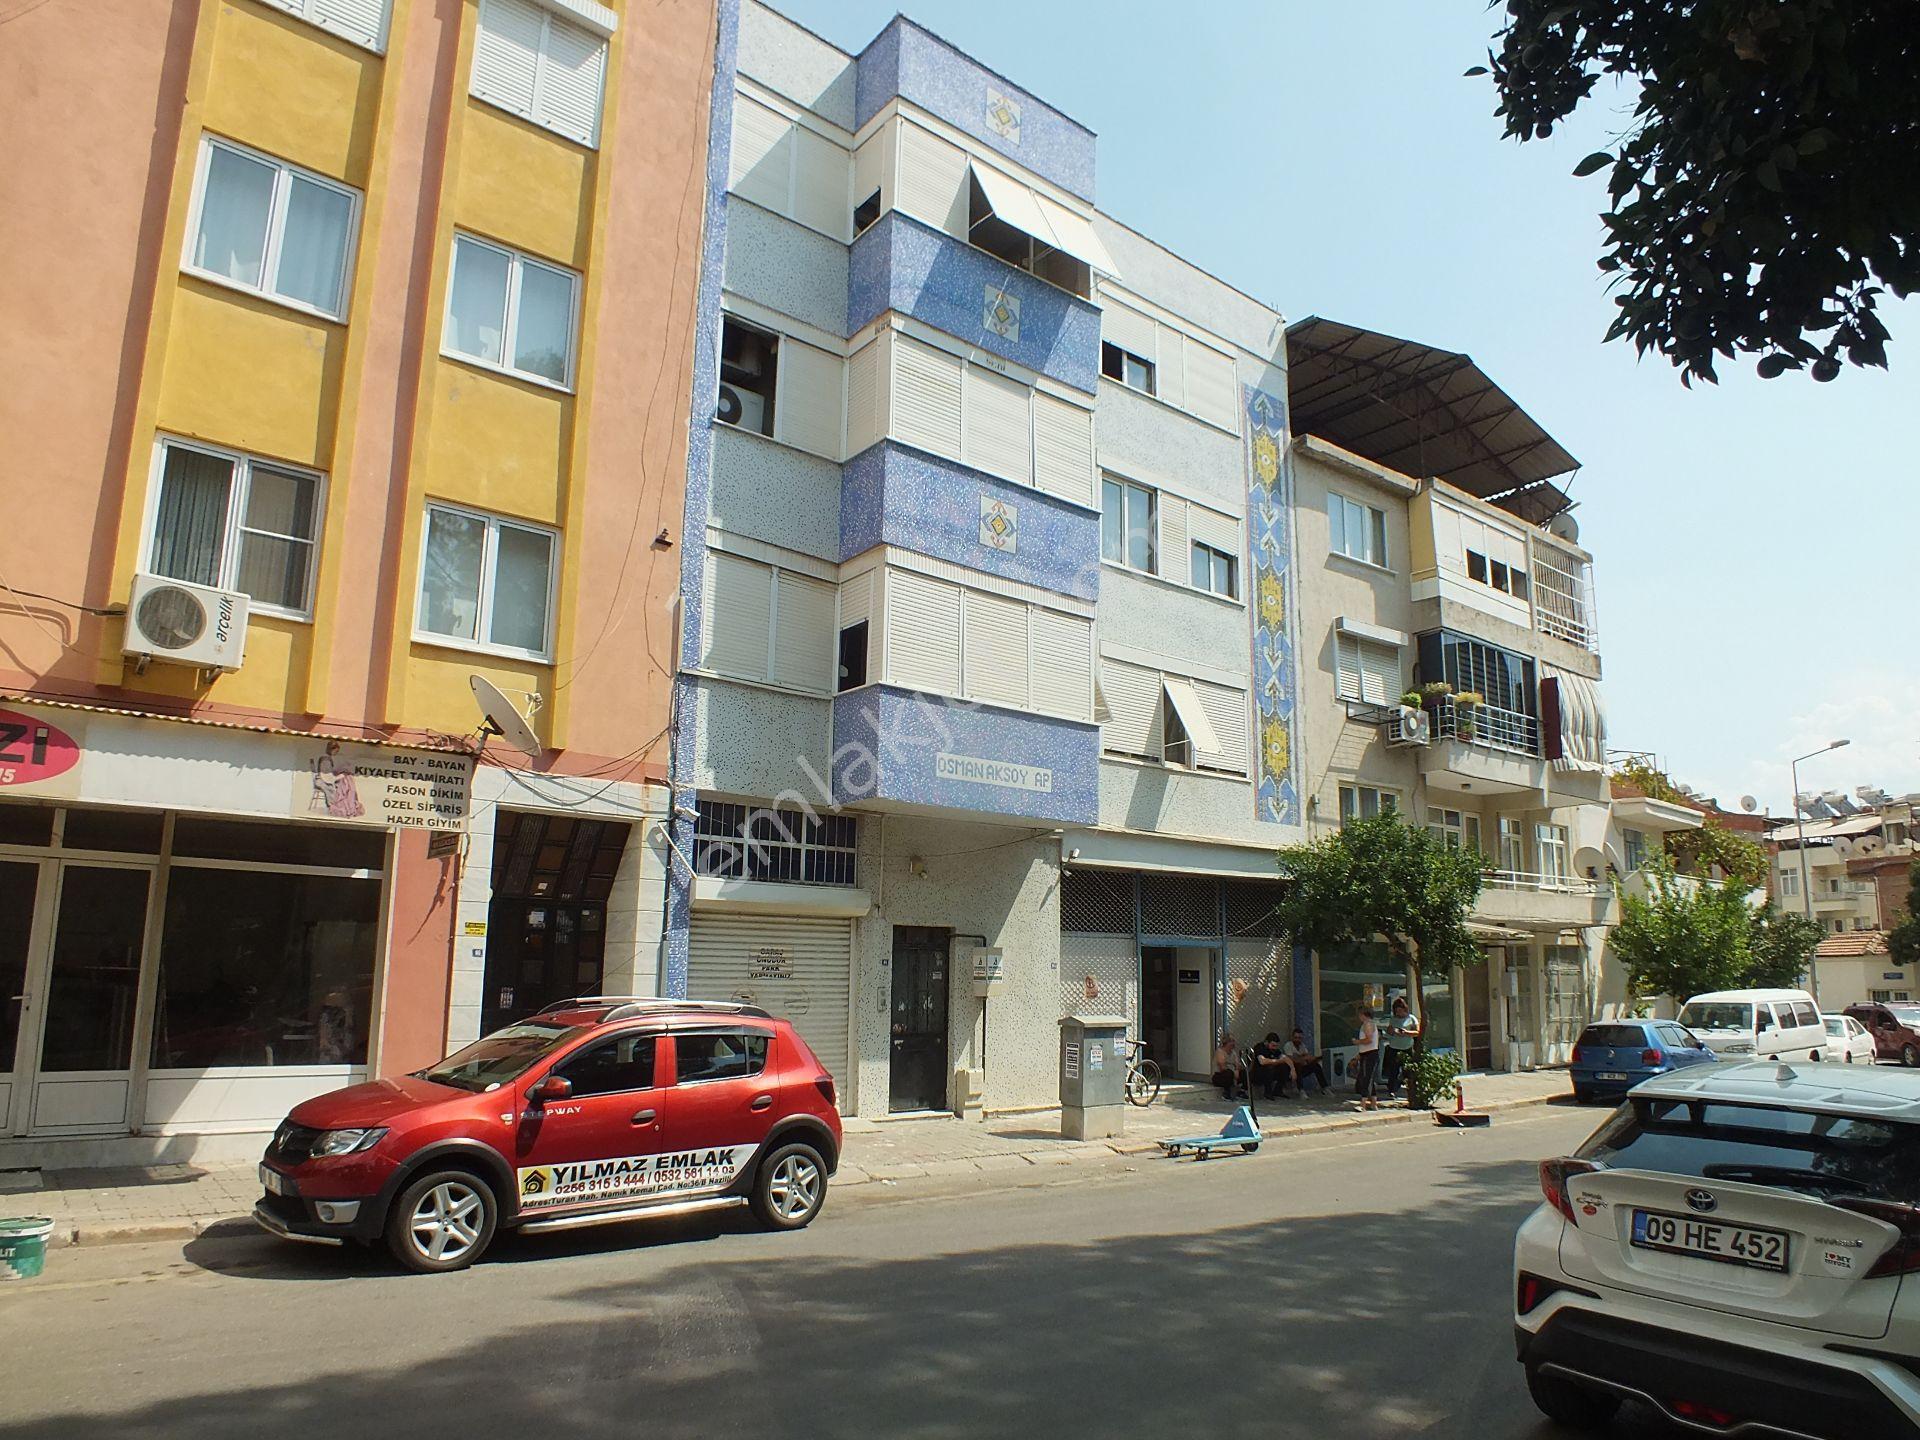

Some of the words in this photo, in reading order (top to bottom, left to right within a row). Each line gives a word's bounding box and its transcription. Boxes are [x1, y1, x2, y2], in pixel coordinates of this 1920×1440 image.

[217, 596, 234, 643] arçelik
[394, 755, 417, 766] BAY
[428, 759, 466, 771] BAYAN
[354, 765, 406, 779] KIYAFET
[1035, 772, 1050, 788] AP
[387, 785, 426, 797] FASON
[382, 798, 413, 810] ÖZEL
[387, 815, 424, 826] HAZIR
[552, 1159, 648, 1185] YILMAZ
[656, 1148, 735, 1169] EMLAK
[588, 1177, 611, 1190] 315
[614, 1175, 621, 1188] 3
[630, 1186, 655, 1195] Kemal
[1646, 1217, 1676, 1243] 09
[1685, 1222, 1722, 1252] HE
[1730, 1231, 1780, 1262] 452
